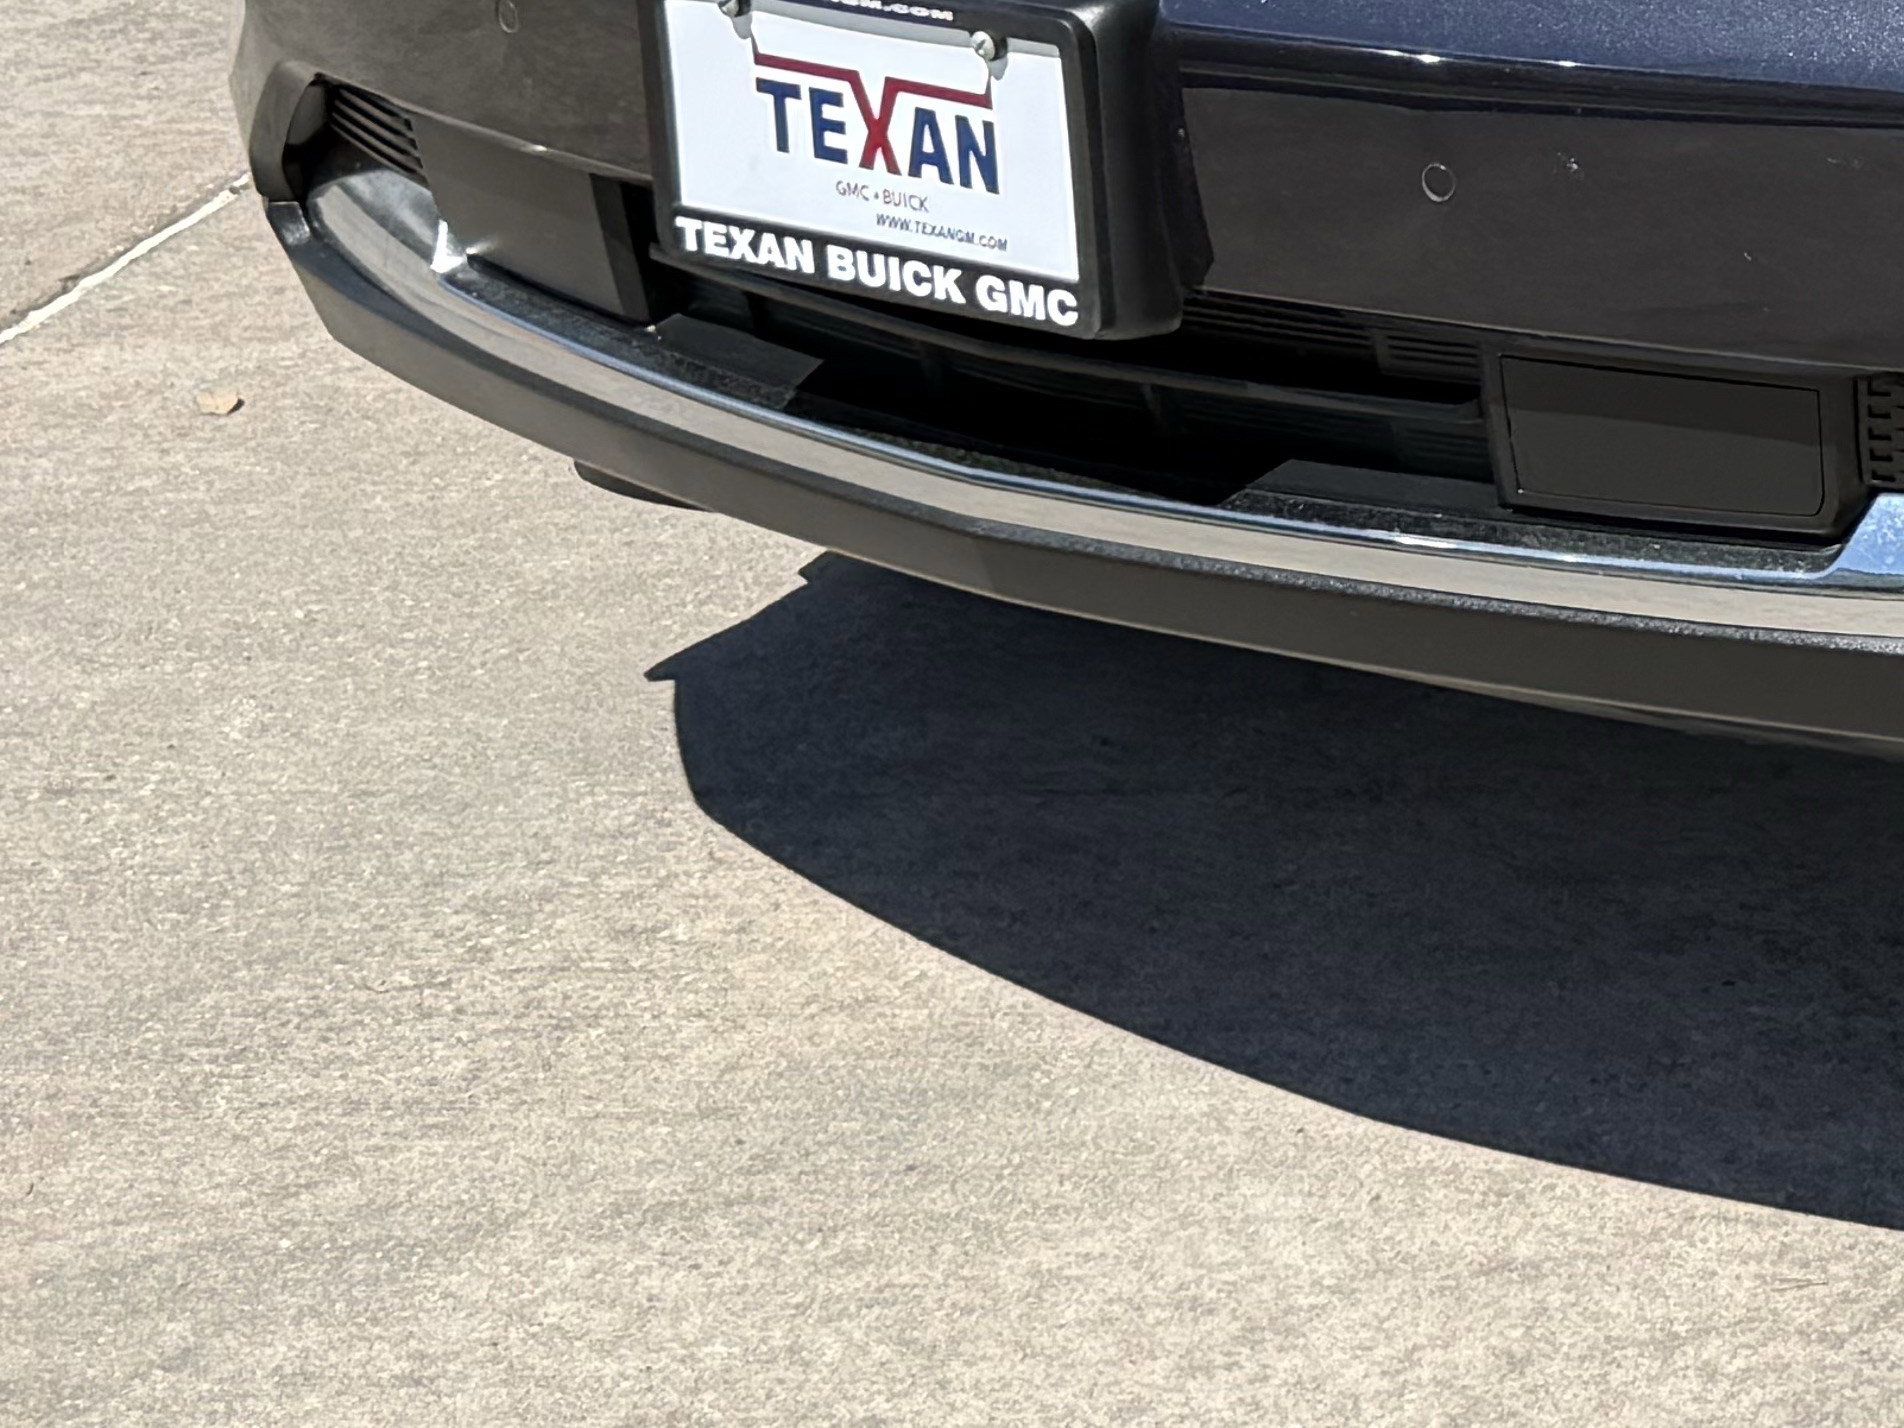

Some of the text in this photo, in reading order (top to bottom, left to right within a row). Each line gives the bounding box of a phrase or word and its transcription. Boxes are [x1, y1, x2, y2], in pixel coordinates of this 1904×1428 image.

[752, 55, 1000, 196] TEXAN
[835, 179, 930, 214] GMC BUICK
[875, 212, 1008, 252] WWW.TEXANGM.COM
[675, 216, 1079, 327] TEXAN BUICK GMC
